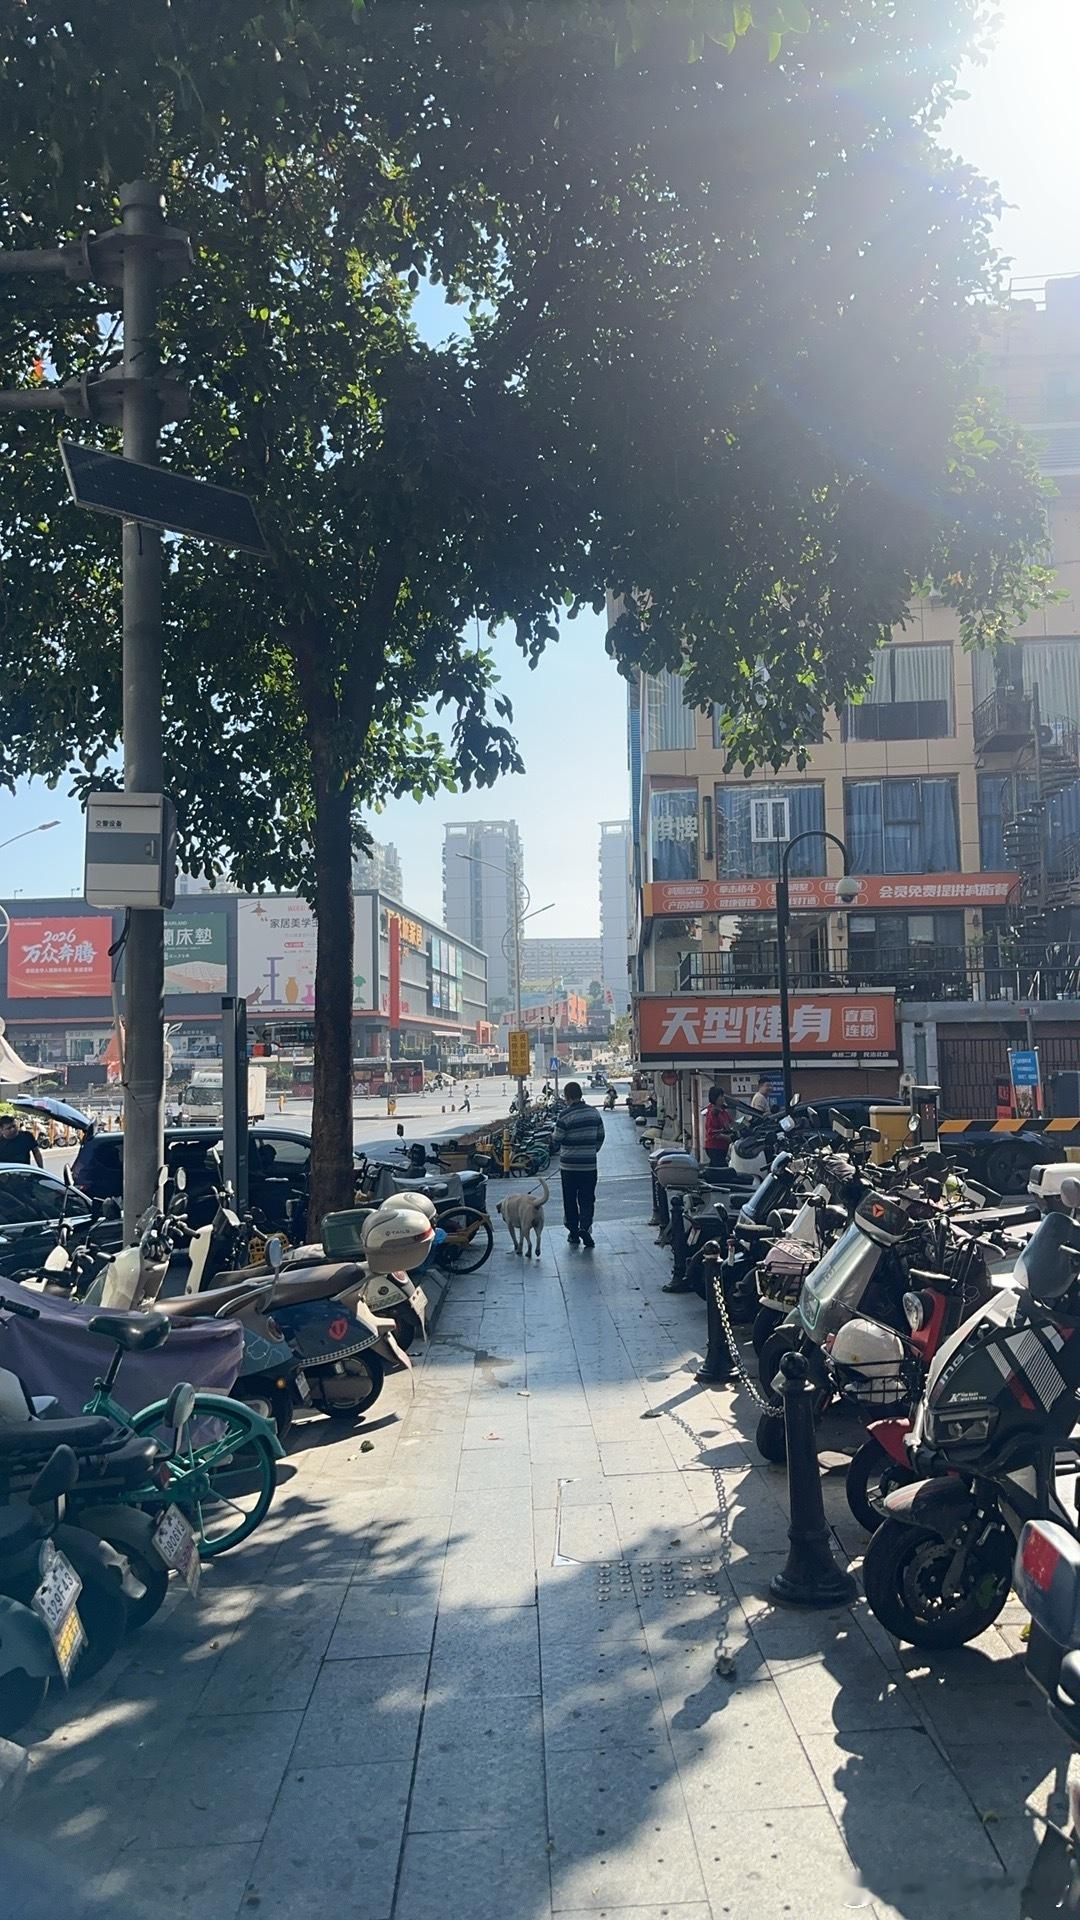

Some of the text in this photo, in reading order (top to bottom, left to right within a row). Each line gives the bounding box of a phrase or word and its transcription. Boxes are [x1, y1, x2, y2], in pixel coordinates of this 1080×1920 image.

[879, 883, 1009, 898] 会员免费提供减脂餐
[42, 928, 76, 944] 2026
[17, 940, 98, 966] 万众奔腾
[845, 1009, 875, 1023] 直营
[659, 1004, 833, 1046] 天型健身
[845, 1024, 875, 1037] 连锁
[737, 1084, 746, 1092] 11
[46, 1572, 74, 1622] 329F43
